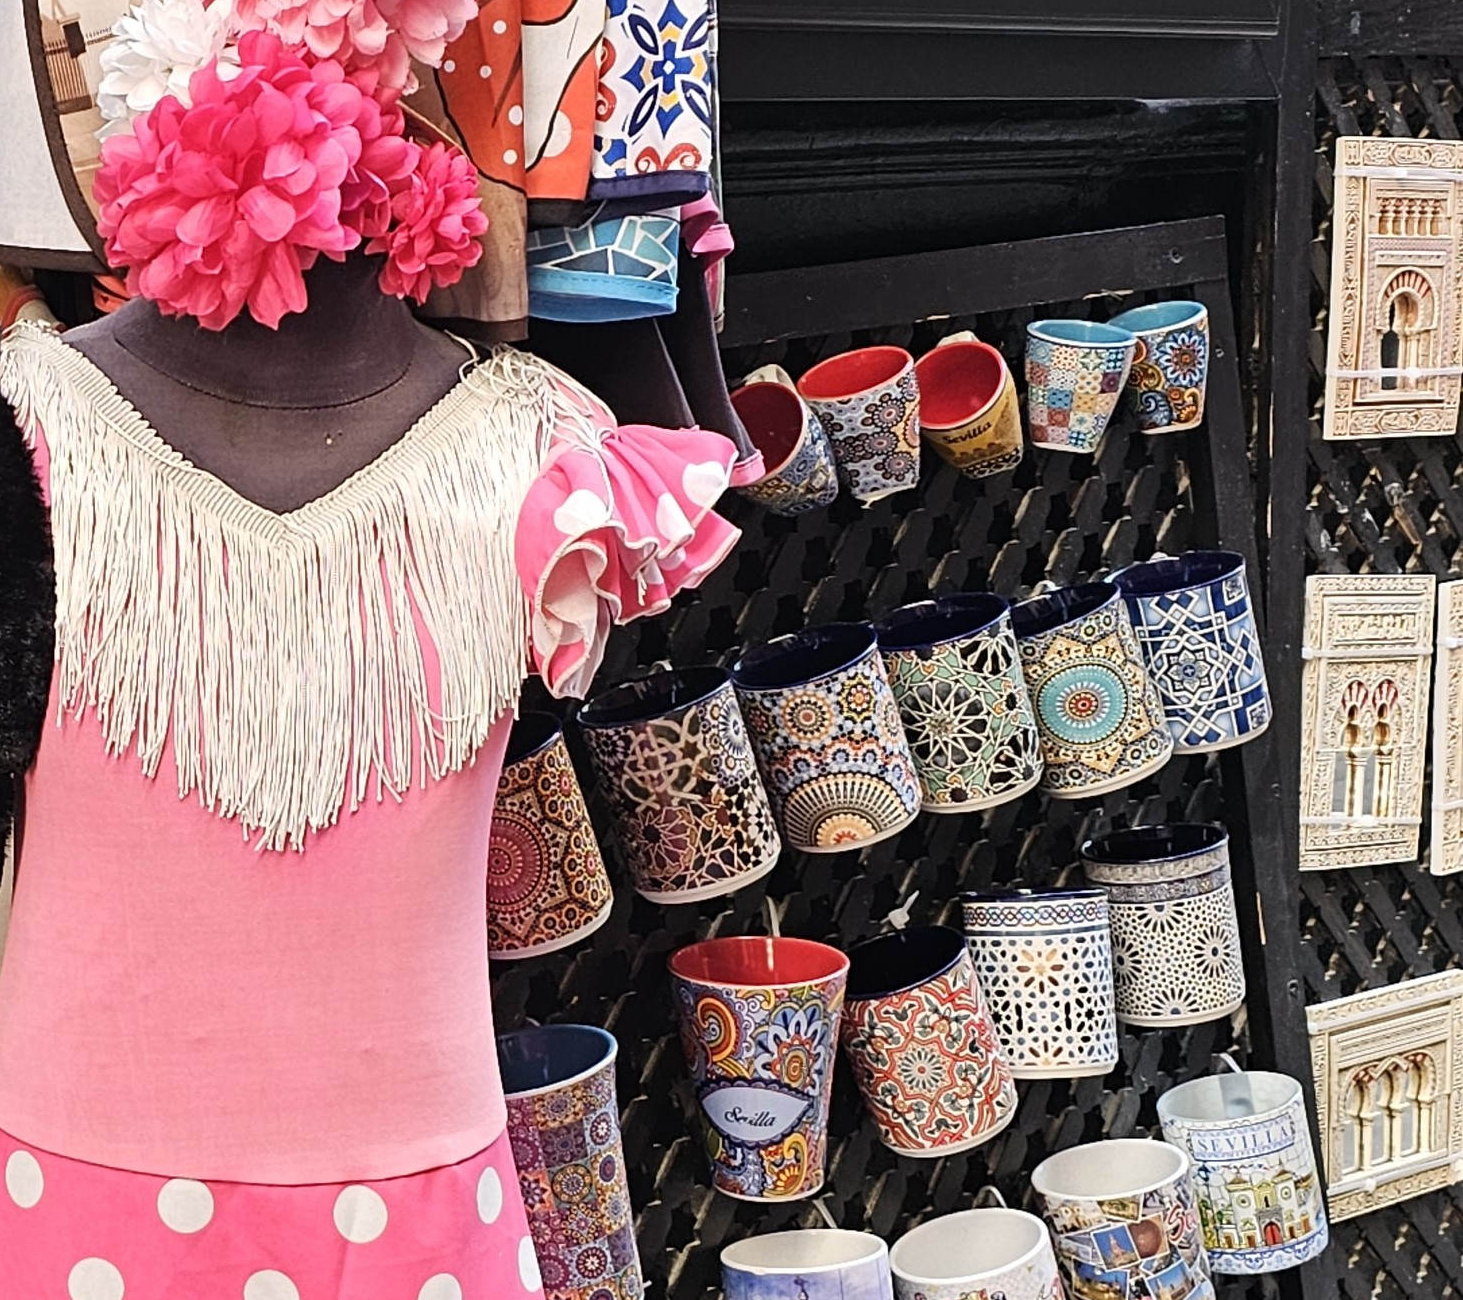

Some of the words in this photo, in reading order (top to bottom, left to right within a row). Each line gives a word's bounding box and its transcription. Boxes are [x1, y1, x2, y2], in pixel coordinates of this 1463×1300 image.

[942, 422, 993, 444] Sevilla
[724, 1106, 777, 1127] Sevilla
[1197, 1126, 1294, 1149] SEVILLA
